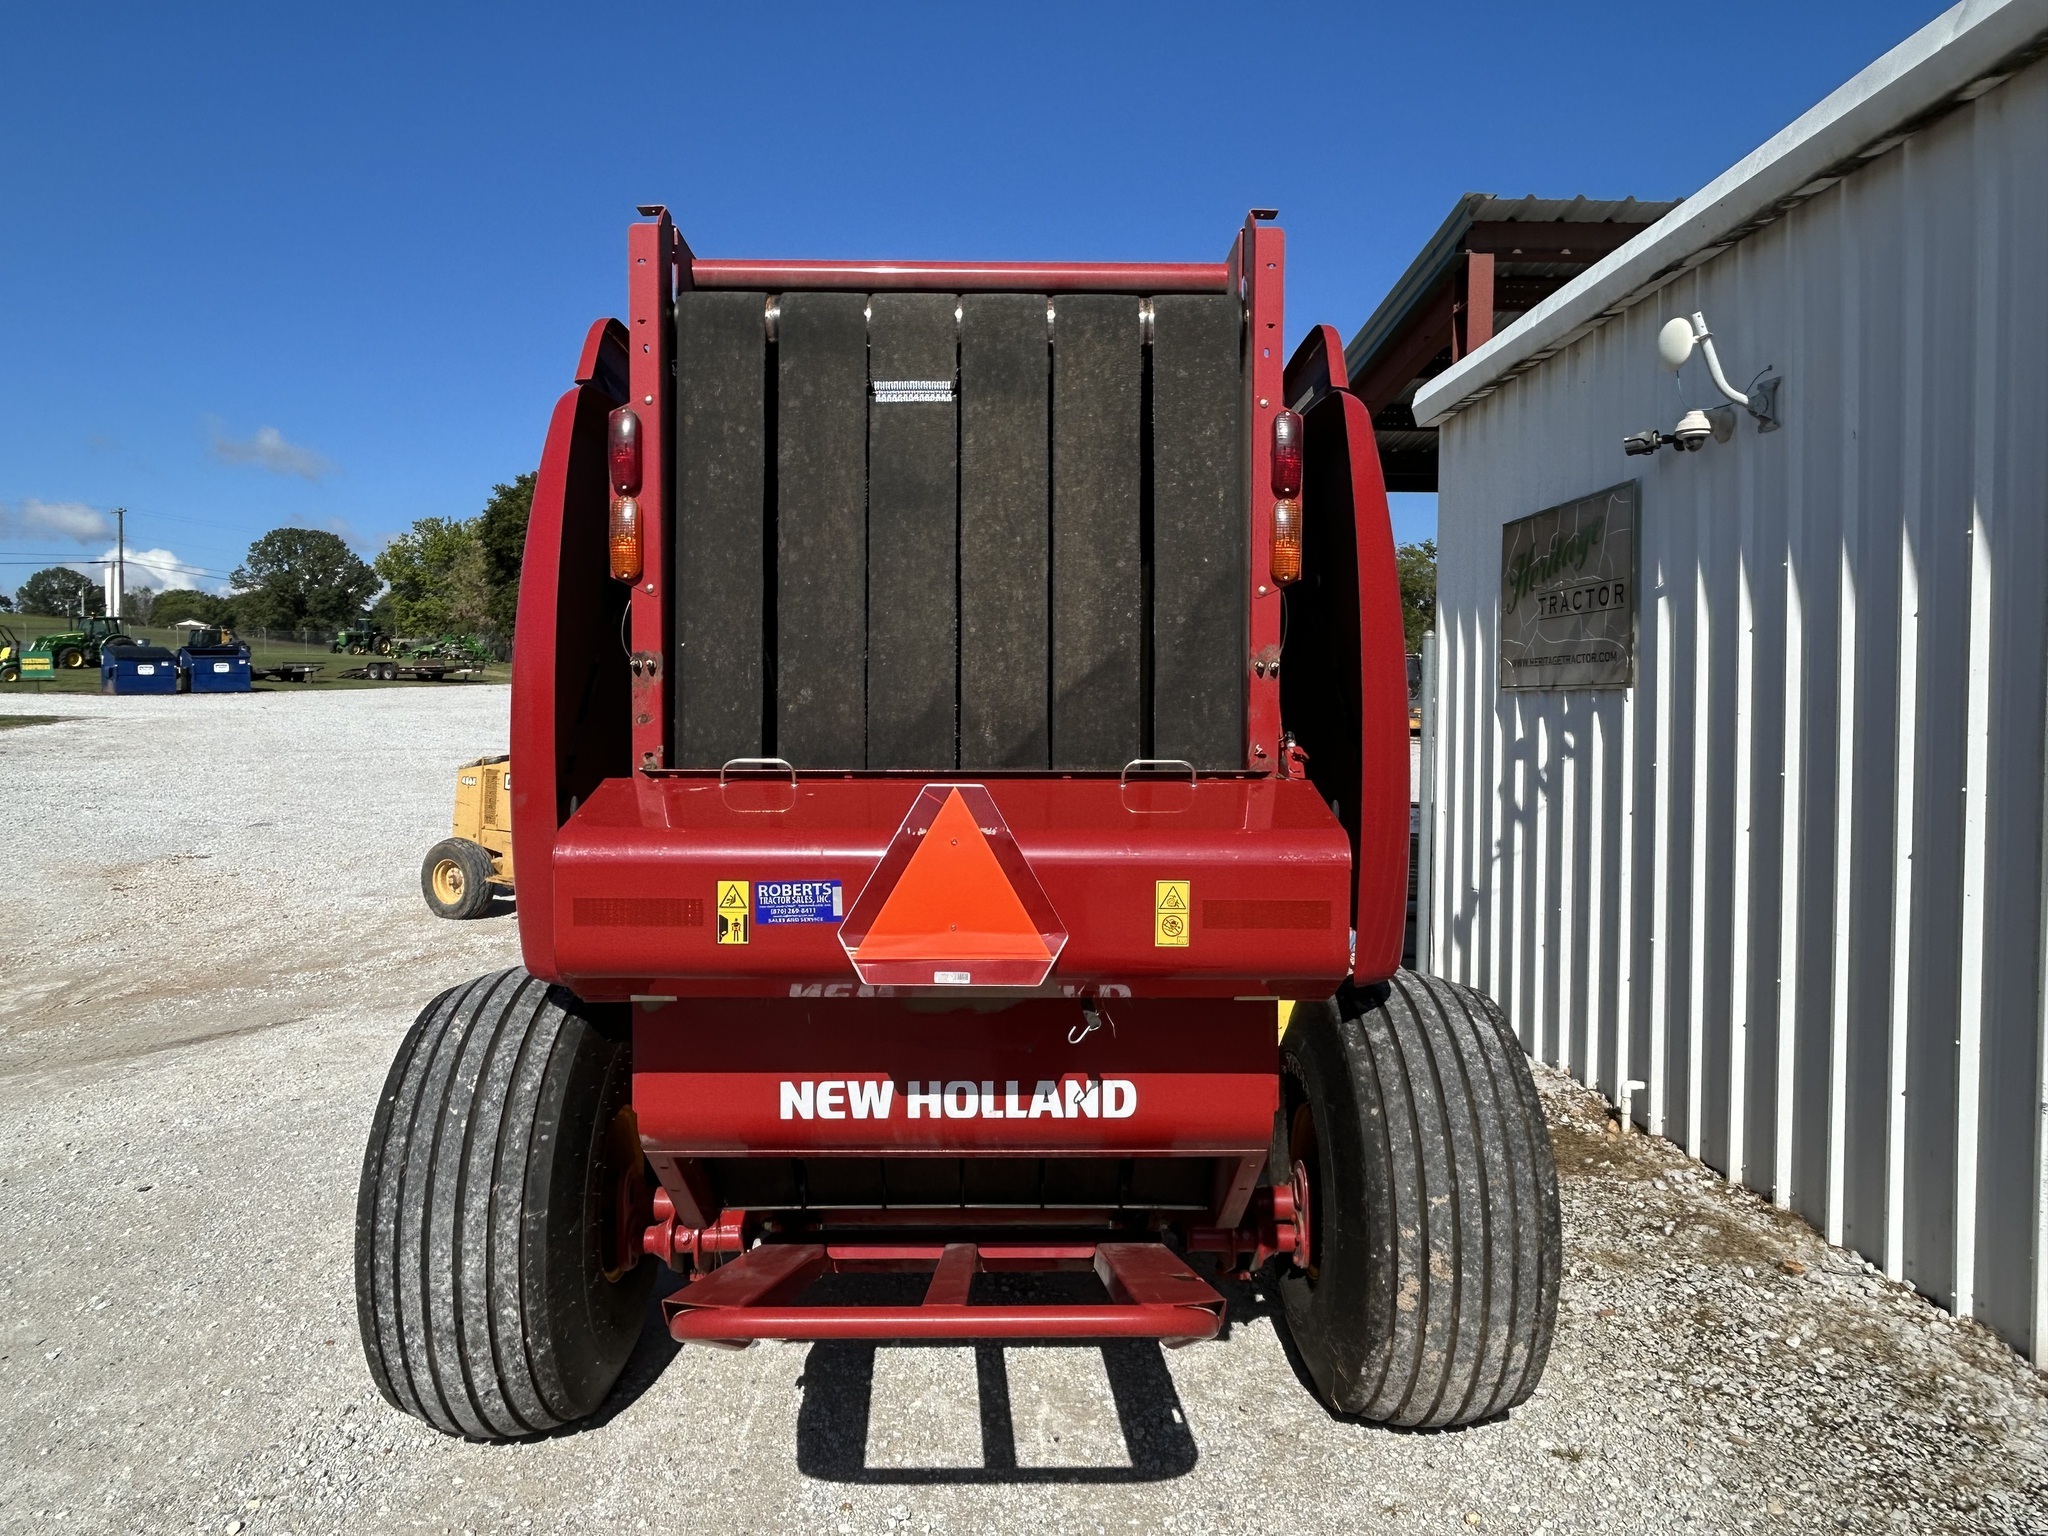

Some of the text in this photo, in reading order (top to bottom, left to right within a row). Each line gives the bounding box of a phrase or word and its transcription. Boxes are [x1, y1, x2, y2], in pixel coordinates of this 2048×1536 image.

[1538, 583, 1625, 616] TRACTOR
[1512, 651, 1618, 668] WWW.HERITAGETRACTOR.COM
[758, 883, 832, 896] ROBERTS
[760, 896, 791, 905] TRACTOR
[791, 895, 815, 904] SALES,
[816, 894, 831, 903] INC.
[780, 1080, 1137, 1119] NEW HOLLAND
